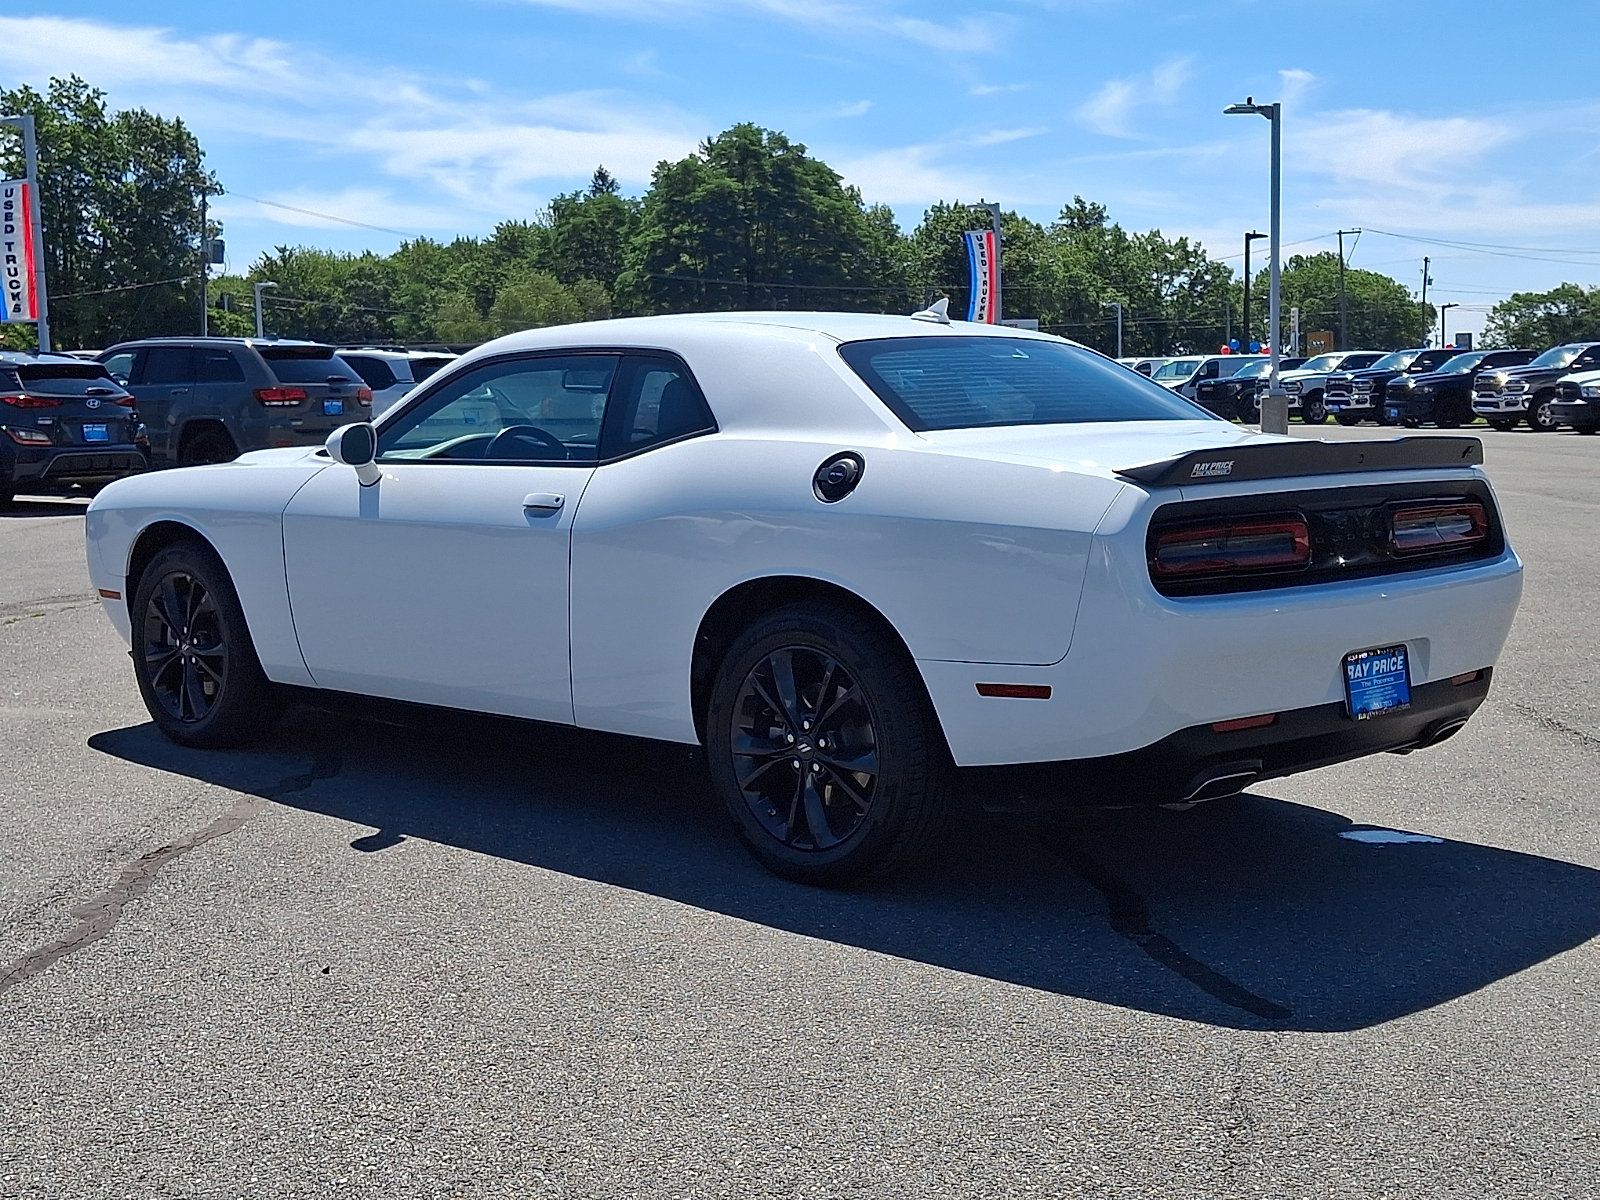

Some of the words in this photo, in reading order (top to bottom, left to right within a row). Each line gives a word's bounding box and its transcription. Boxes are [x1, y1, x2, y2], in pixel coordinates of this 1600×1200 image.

[3, 188, 14, 234] USED
[975, 234, 987, 267] USED
[4, 241, 22, 314] TRUCKS
[977, 271, 988, 321] TRUCKS
[1194, 462, 1211, 472] RAY
[1210, 460, 1235, 471] PRICE
[1347, 662, 1370, 679] RAY
[1372, 655, 1404, 675] PRICE
